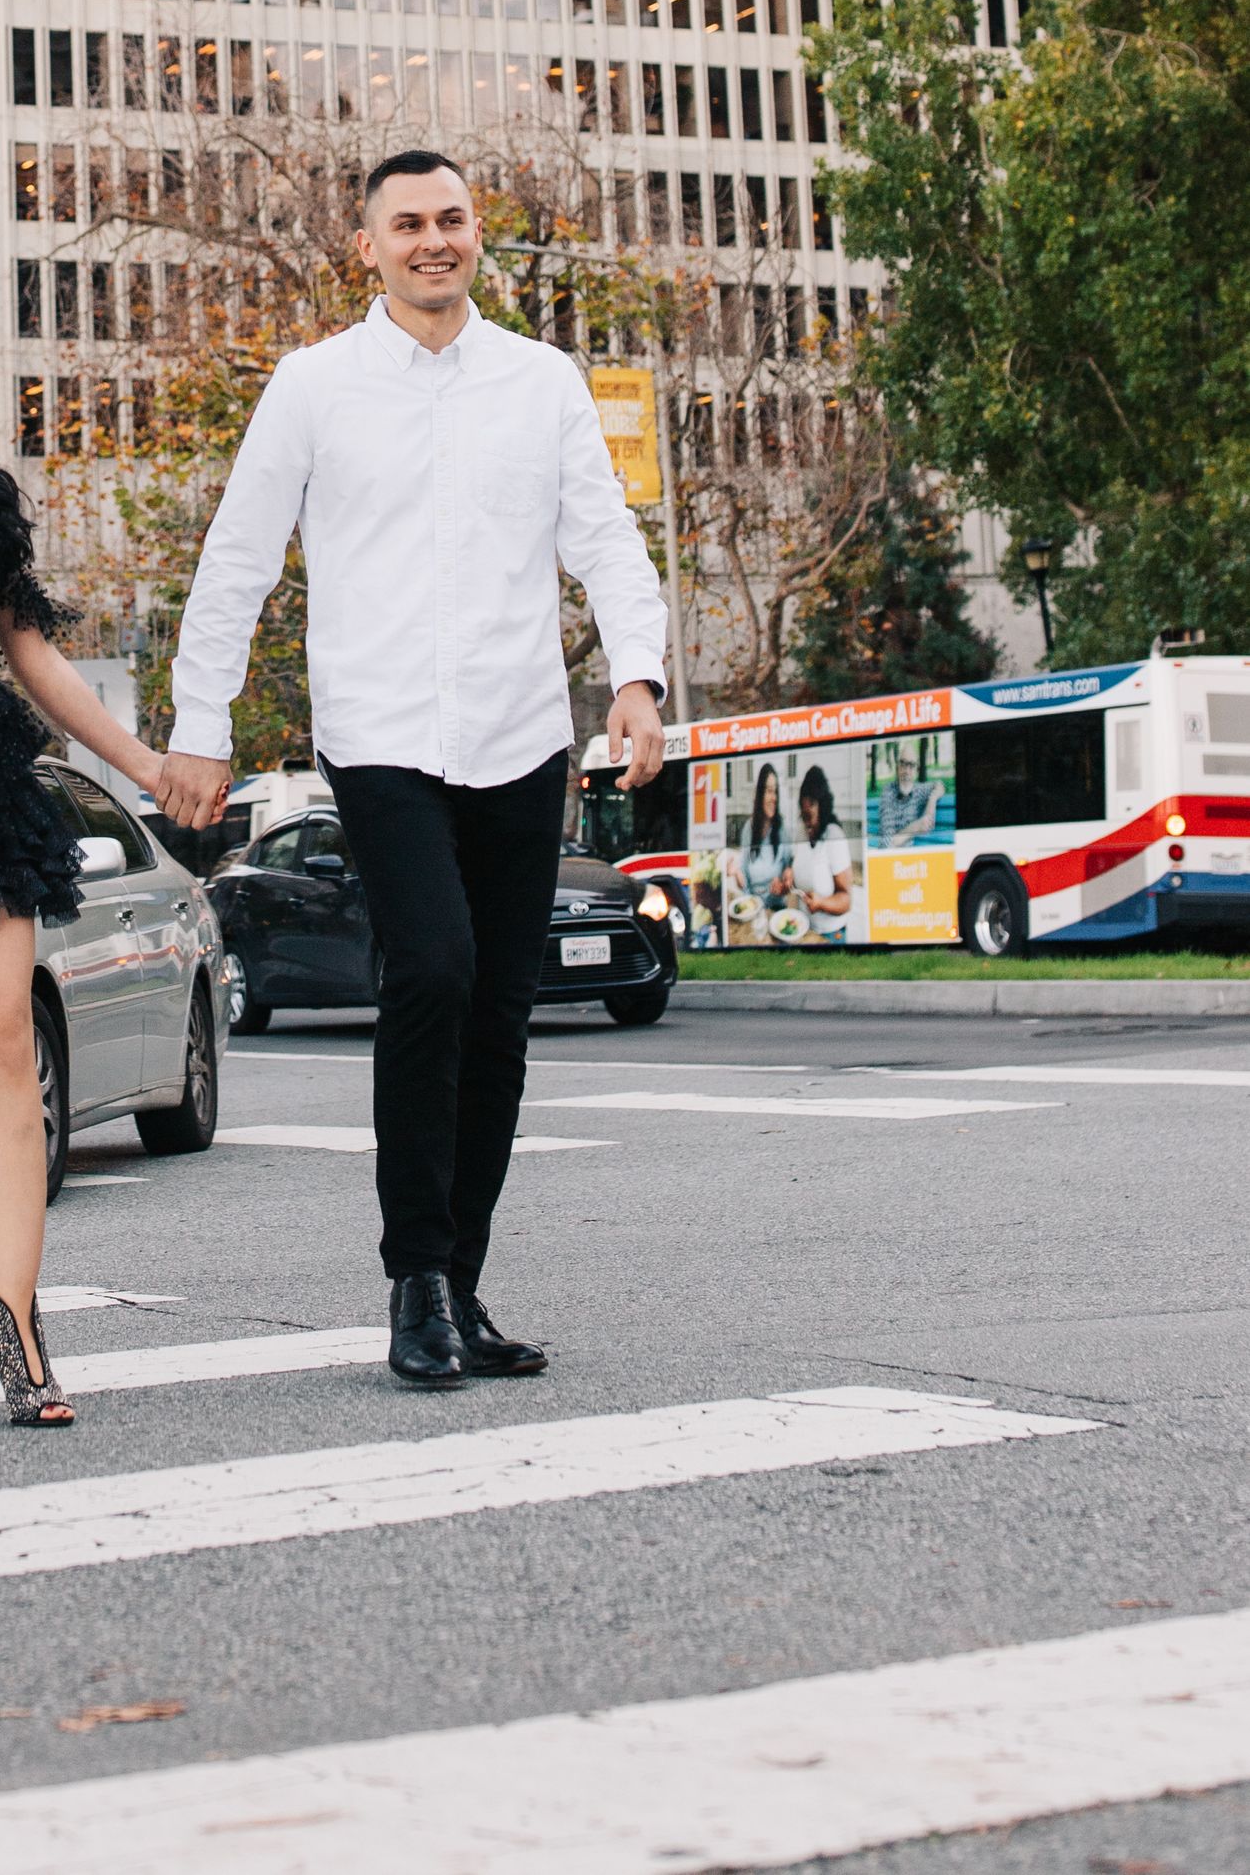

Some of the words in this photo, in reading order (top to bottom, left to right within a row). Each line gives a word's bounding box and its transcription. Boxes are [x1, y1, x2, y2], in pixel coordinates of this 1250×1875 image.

[992, 677, 1099, 705] www.samtrans.com
[698, 726, 728, 751] Your
[730, 723, 768, 751] Spare
[770, 718, 809, 742] Room
[811, 711, 838, 738] Can
[840, 707, 893, 735] Change
[894, 700, 908, 725] A
[910, 695, 941, 724] Life
[893, 860, 917, 879] Rent
[899, 883, 924, 904] with
